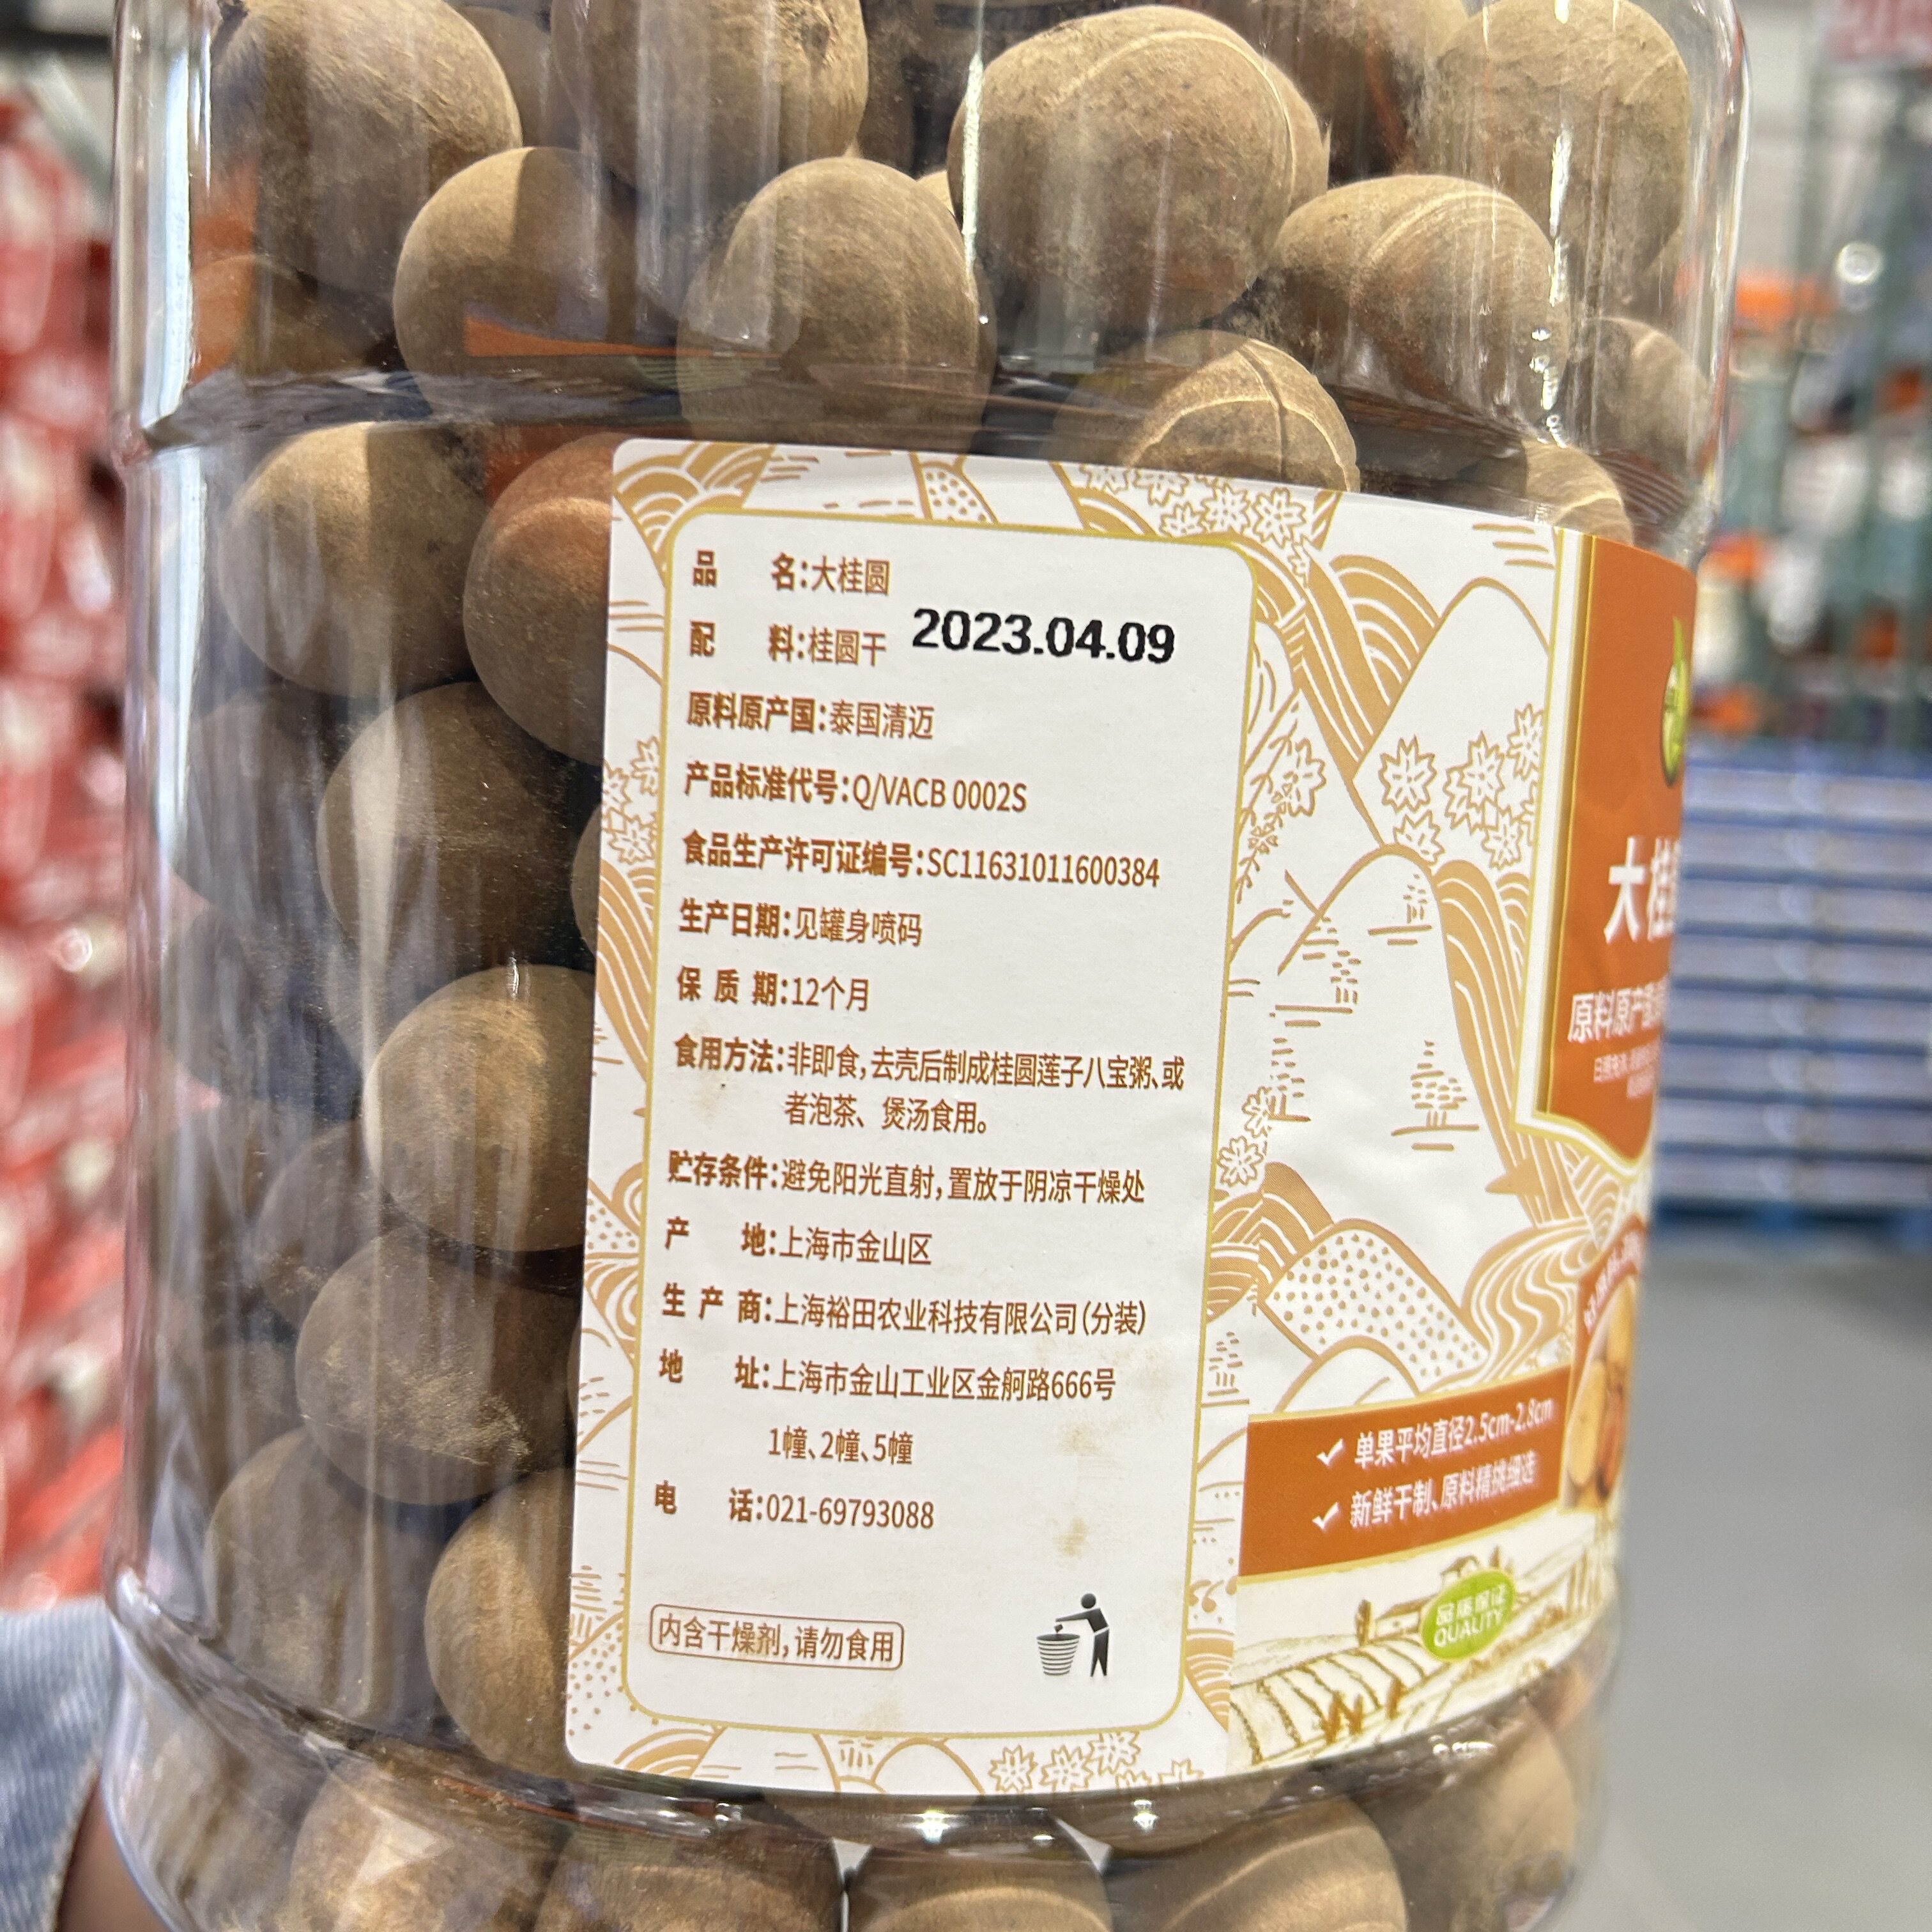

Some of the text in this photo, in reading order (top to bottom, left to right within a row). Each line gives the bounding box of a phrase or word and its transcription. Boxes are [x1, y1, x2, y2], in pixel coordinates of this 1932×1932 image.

[912, 608, 1176, 665] 2023.04.09
[686, 691, 935, 740] 原料原产国:泰国清迈
[682, 829, 1161, 888] 食品生产许可证编号:SC11631011600384
[1602, 836, 1682, 944] 大桂
[678, 897, 923, 947] 生产日期:见罐身喷码
[667, 1149, 1146, 1205] 贮存条件:避免阳光直射,置放于阴凉干燥处
[768, 1425, 914, 1466] 1幢、2幢、5幢
[658, 1613, 895, 1662] 内含干燥剂,请勿食用
[1434, 1609, 1503, 1647] QUALITY
